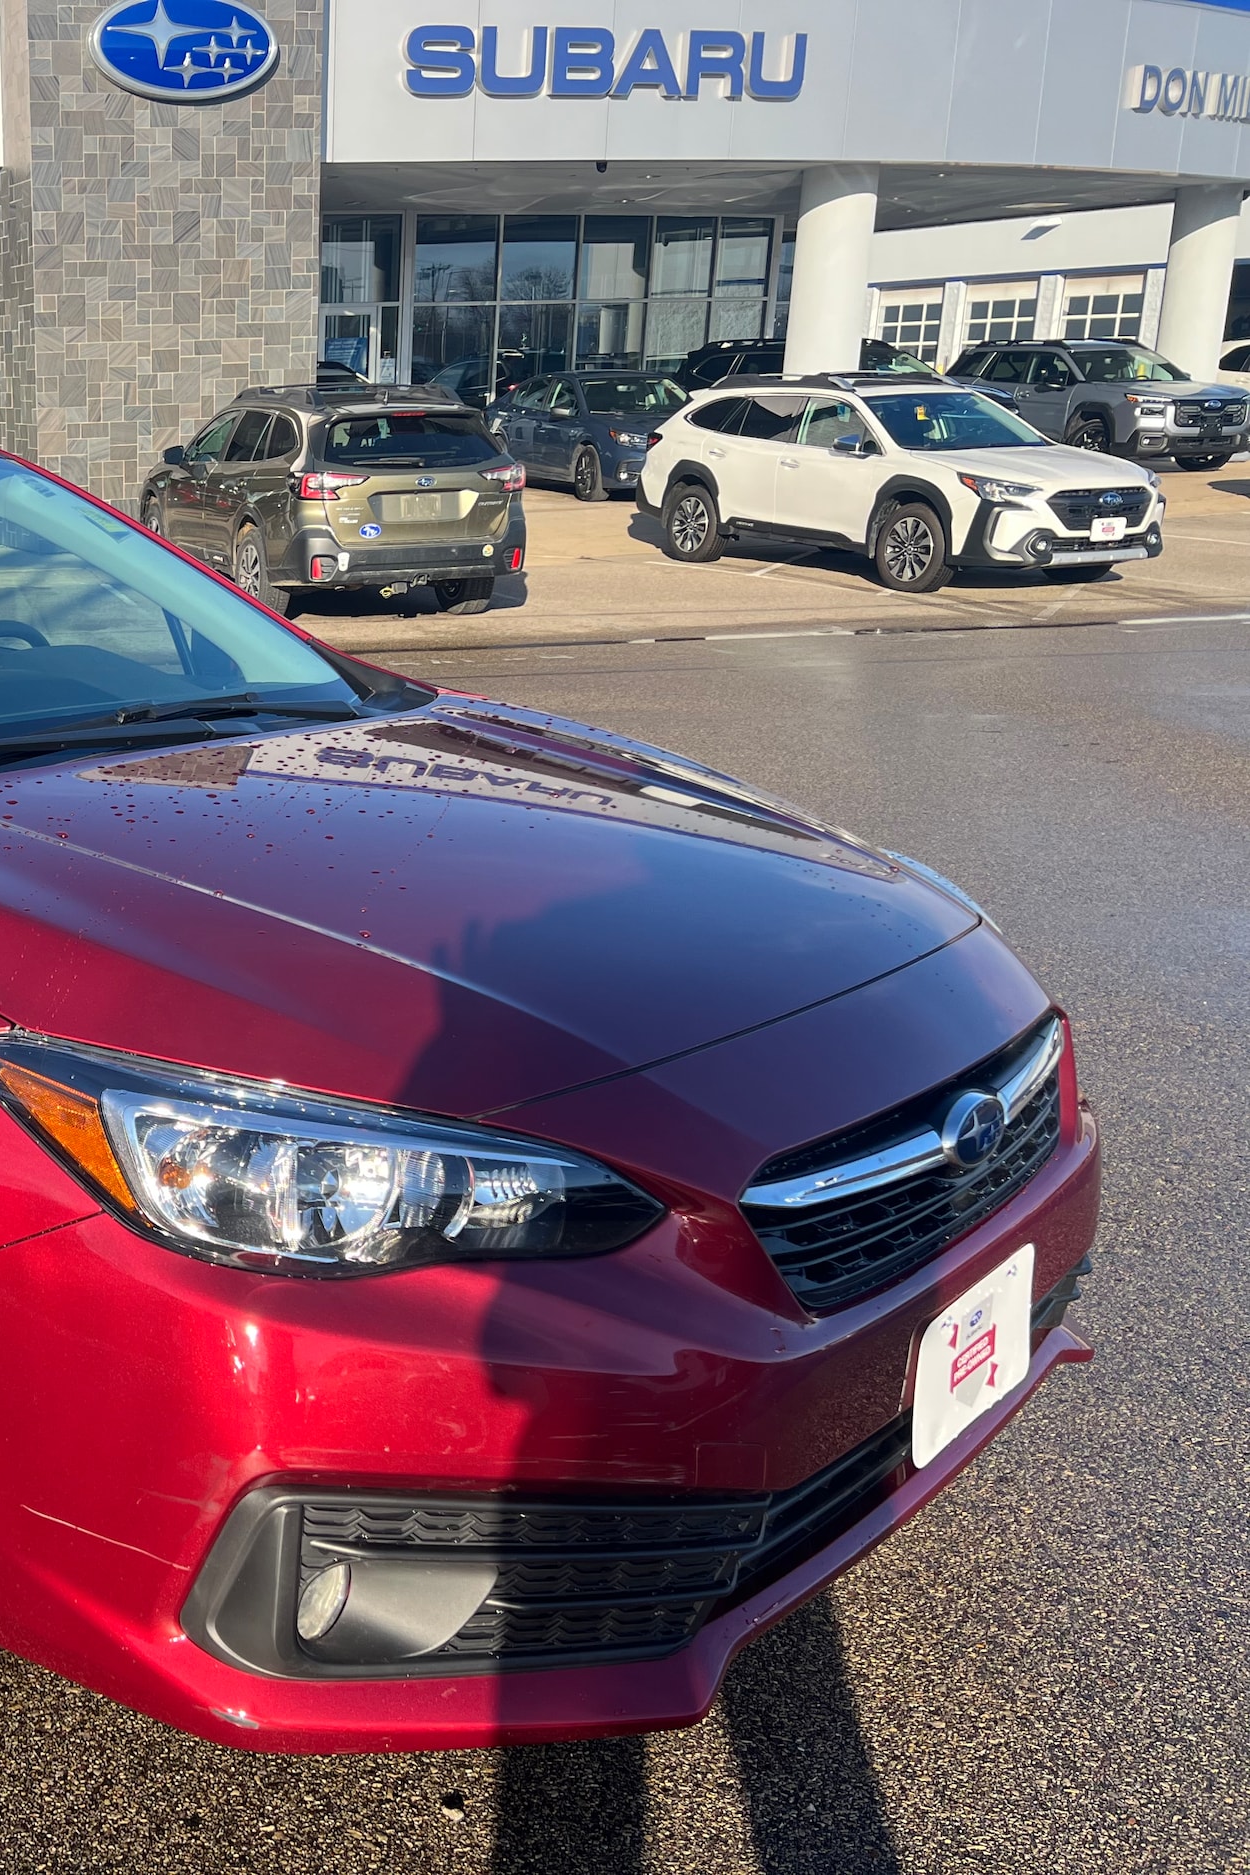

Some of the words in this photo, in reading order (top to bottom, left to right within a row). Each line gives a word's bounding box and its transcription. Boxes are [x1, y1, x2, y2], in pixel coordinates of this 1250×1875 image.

[406, 24, 808, 102] SUBARU
[1134, 64, 1210, 116] DON
[1213, 73, 1250, 121] MI
